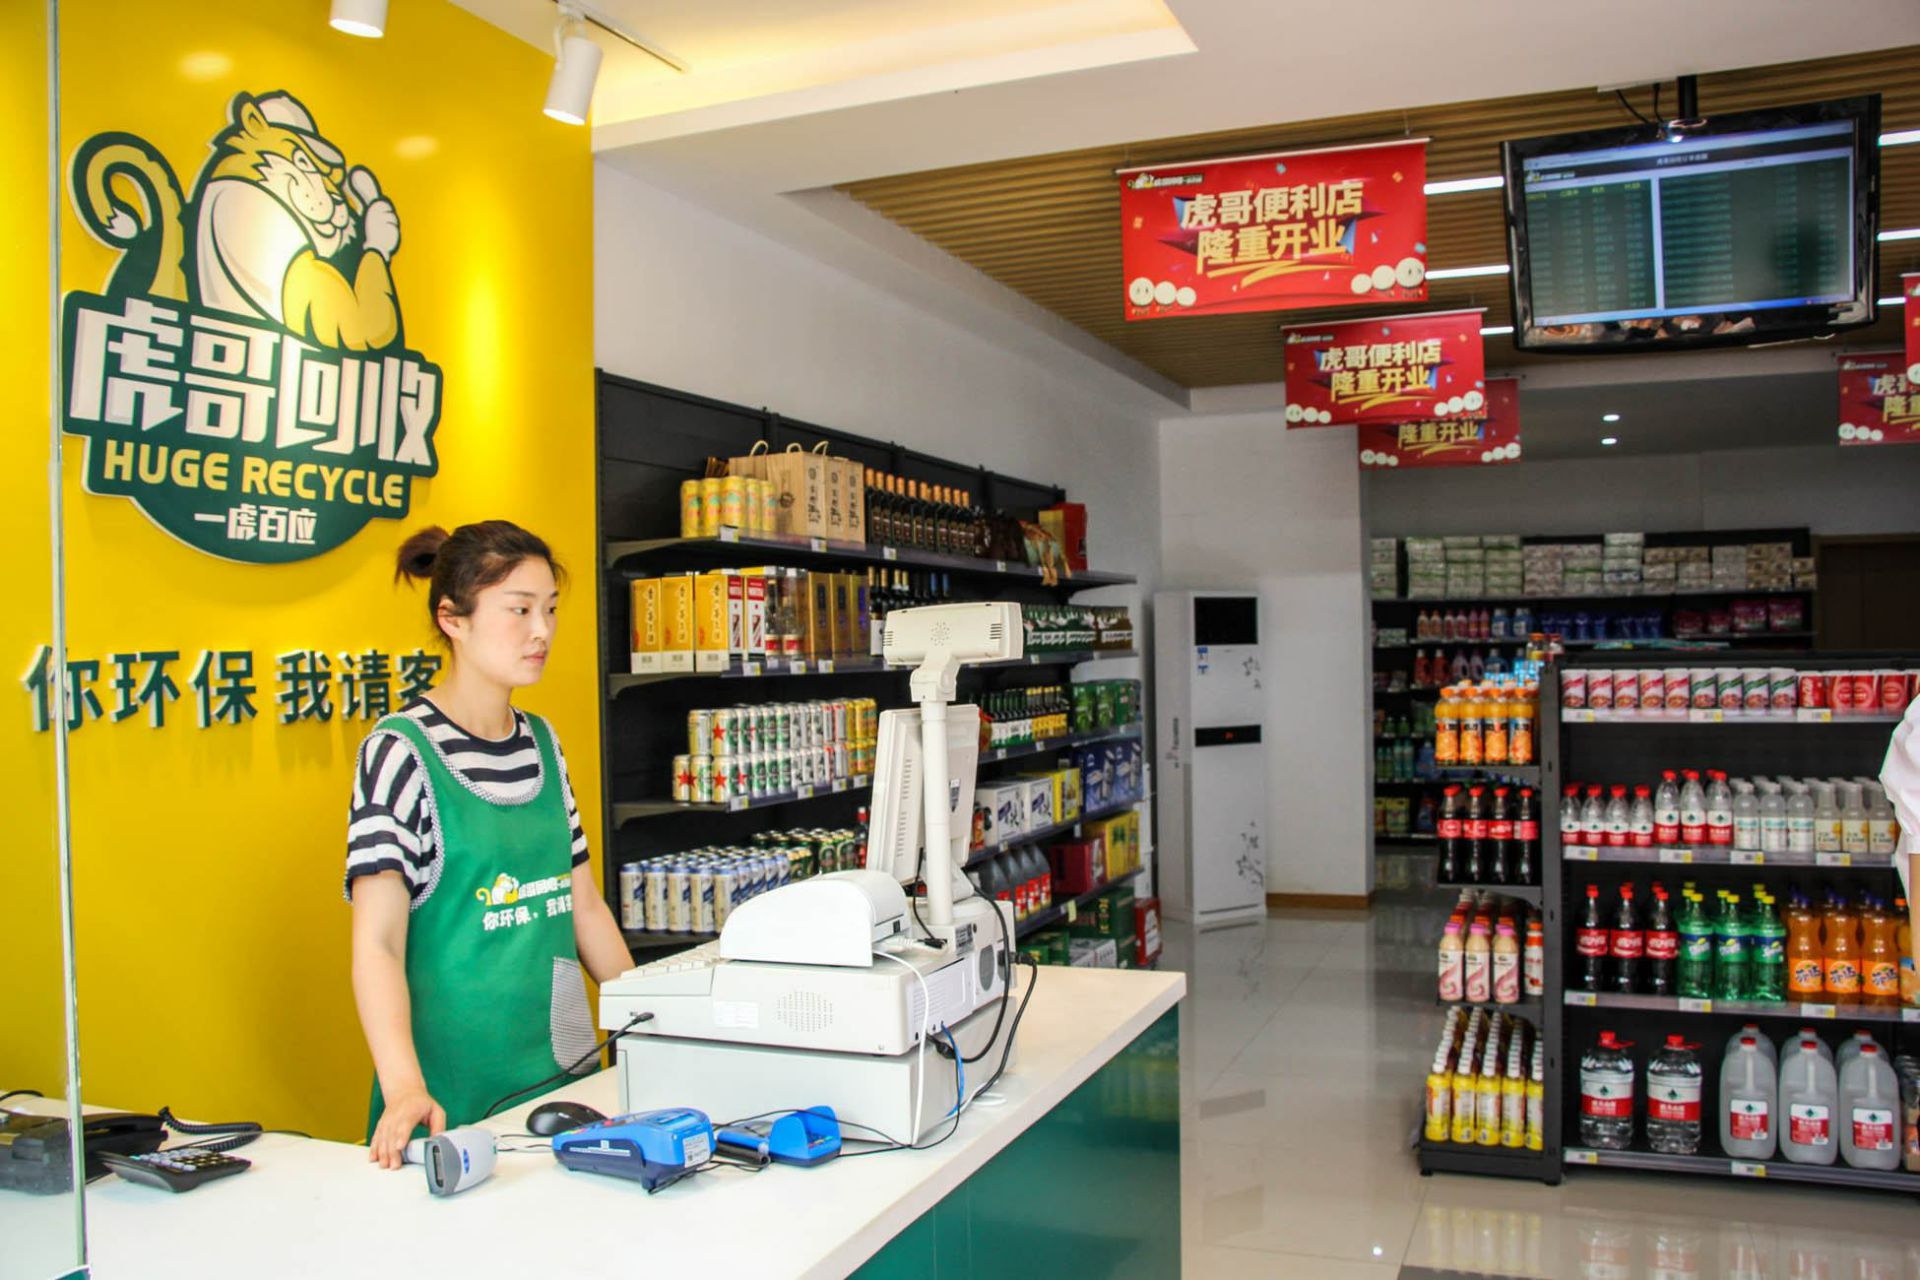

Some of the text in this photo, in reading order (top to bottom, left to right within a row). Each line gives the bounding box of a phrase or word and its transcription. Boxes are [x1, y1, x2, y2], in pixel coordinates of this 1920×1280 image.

[1180, 181, 1364, 230] 虎哥便利店
[1196, 218, 1347, 275] 隆重开业
[1319, 339, 1443, 371] 虎哥便利店
[70, 297, 438, 467] 虎哥回收
[1331, 365, 1431, 403] 隆重开业
[1398, 420, 1480, 449] 隆重开业
[103, 439, 404, 508] HUGE RECYCLE
[194, 503, 317, 545] 一虎百应
